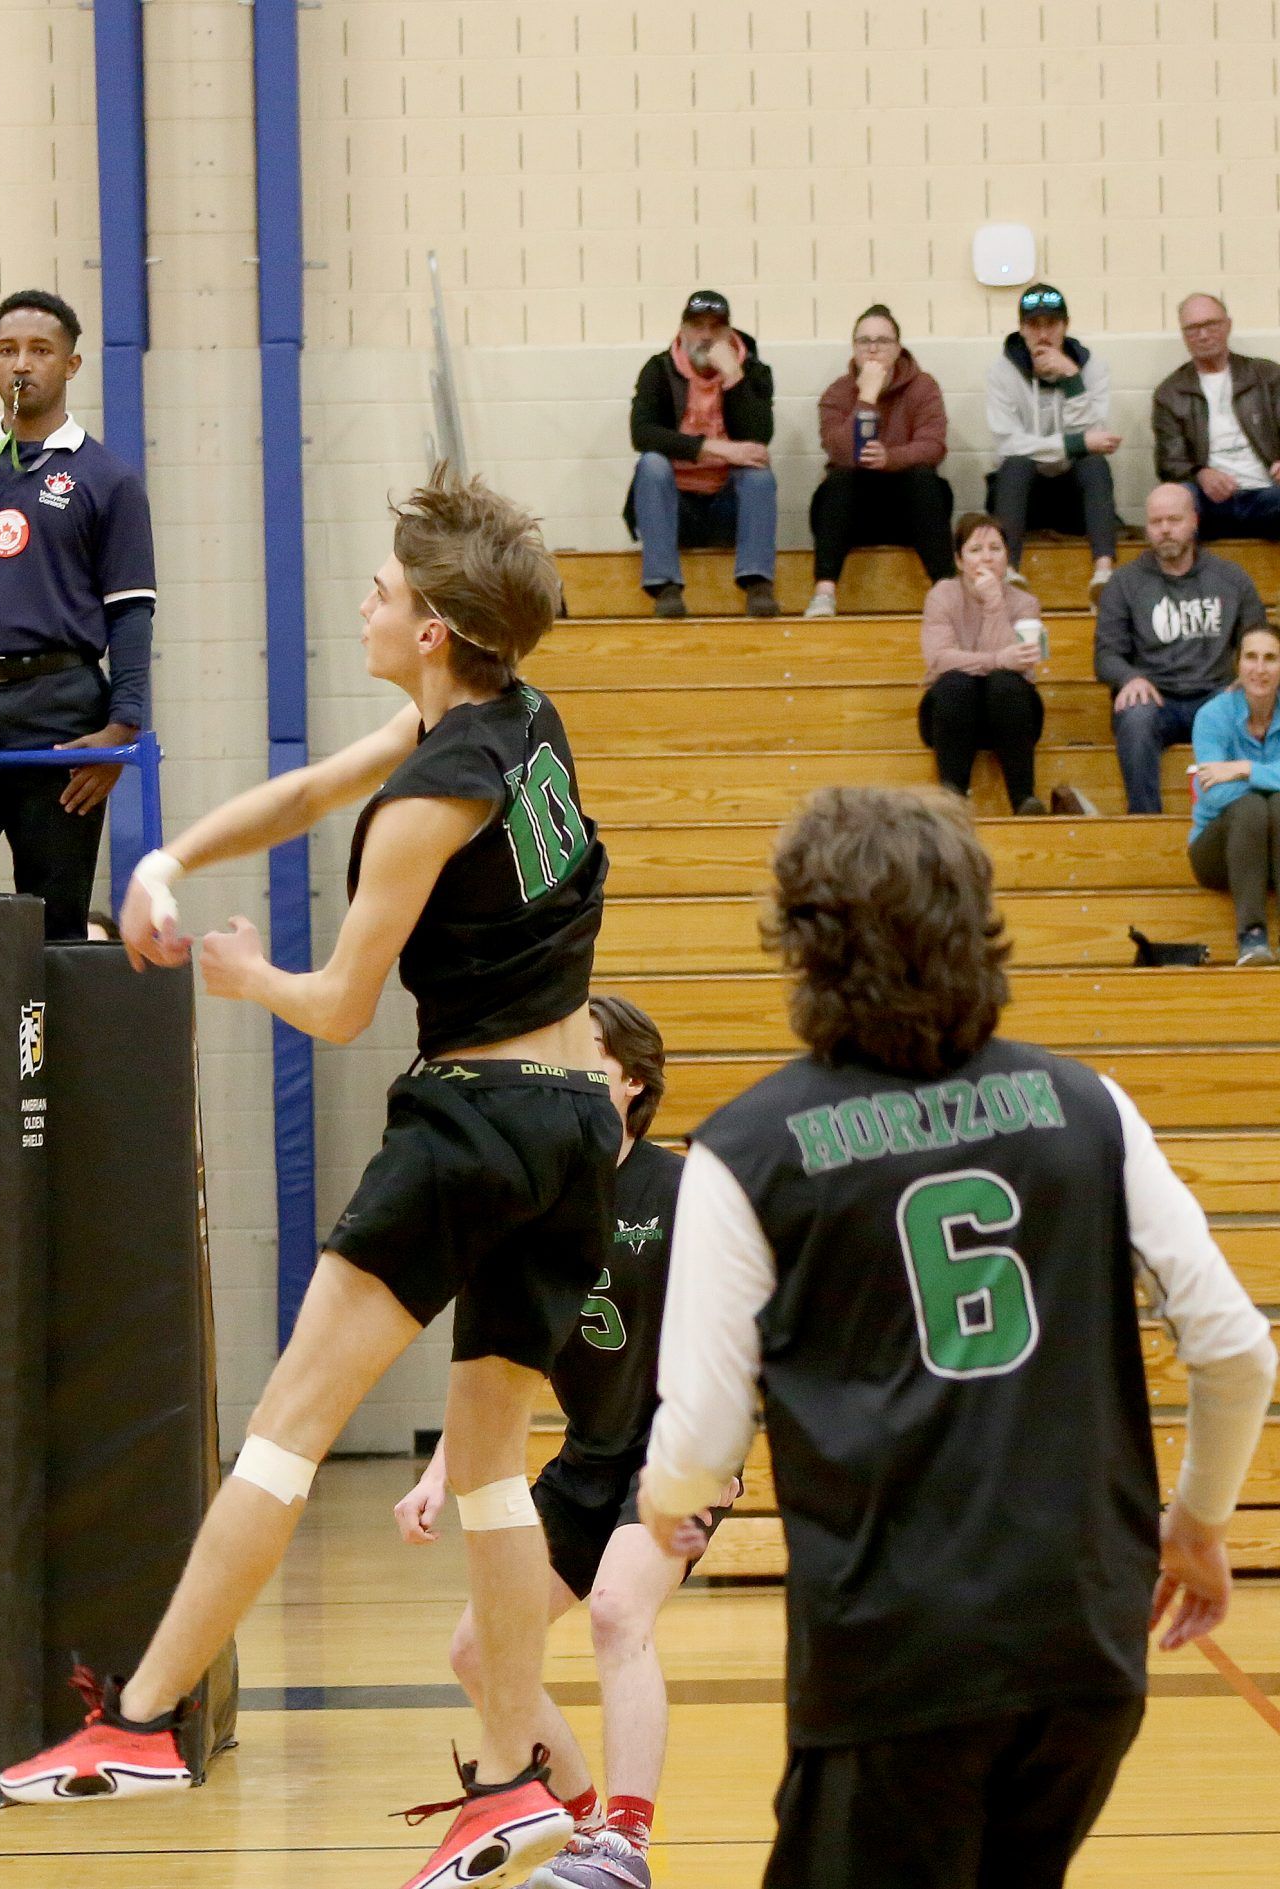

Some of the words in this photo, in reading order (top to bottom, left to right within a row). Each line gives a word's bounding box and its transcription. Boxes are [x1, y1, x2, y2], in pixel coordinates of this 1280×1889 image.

[503, 742, 589, 904] 10
[22, 1133, 44, 1148] SHIELD
[785, 1069, 1067, 1177] HORIZON
[579, 1266, 628, 1351] 5
[895, 1168, 1040, 1380] 6
